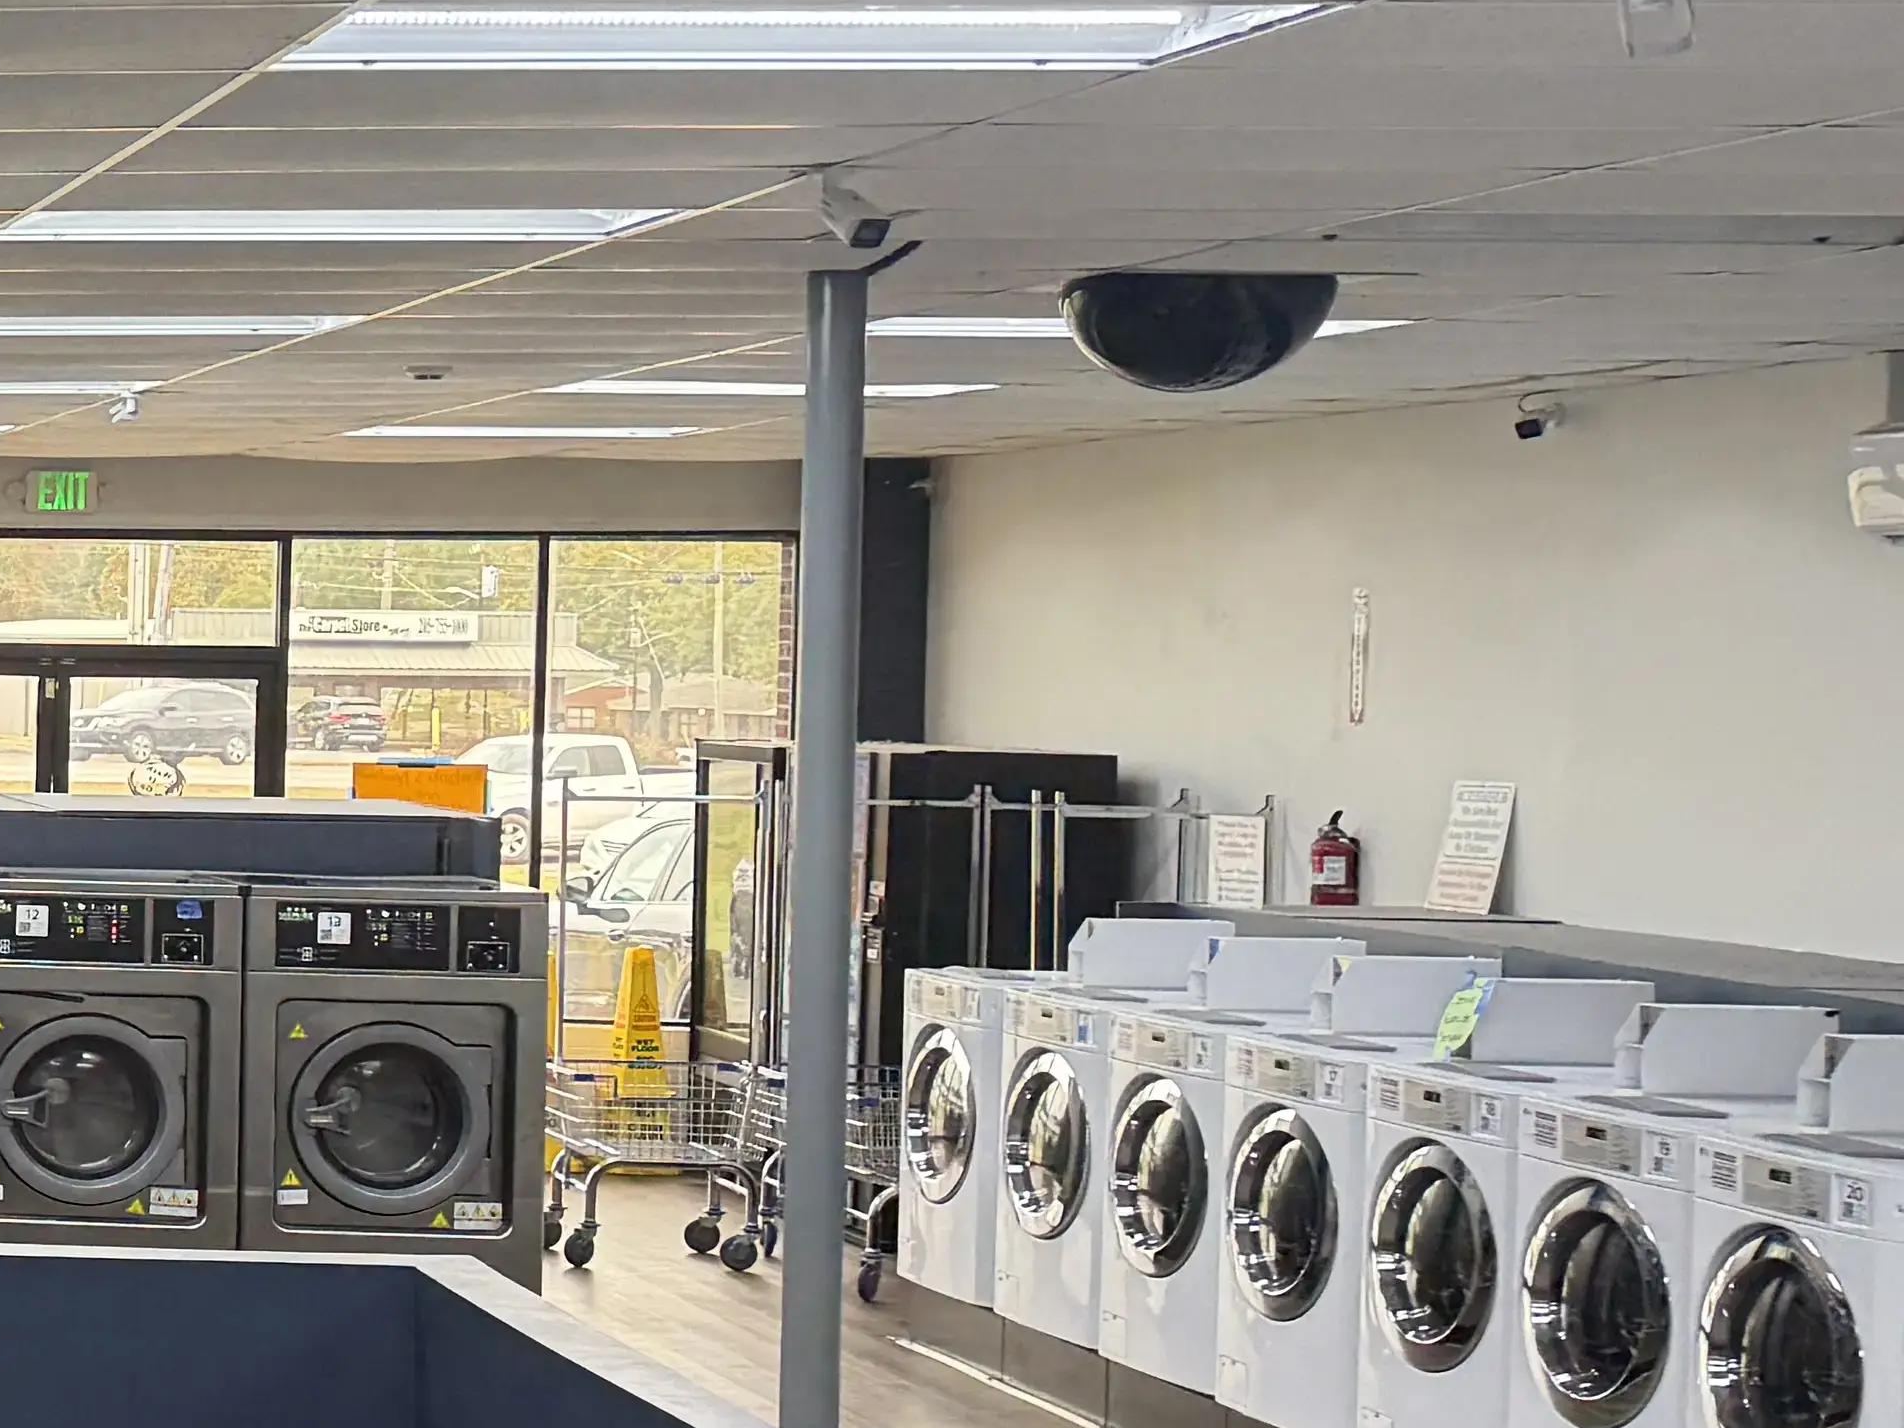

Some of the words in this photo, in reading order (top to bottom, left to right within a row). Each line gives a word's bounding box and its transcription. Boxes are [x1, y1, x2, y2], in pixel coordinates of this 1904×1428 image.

[38, 472, 89, 510] EXIT
[351, 618, 380, 632] Store
[25, 908, 40, 920] 12
[1847, 1183, 1864, 1202] 20
